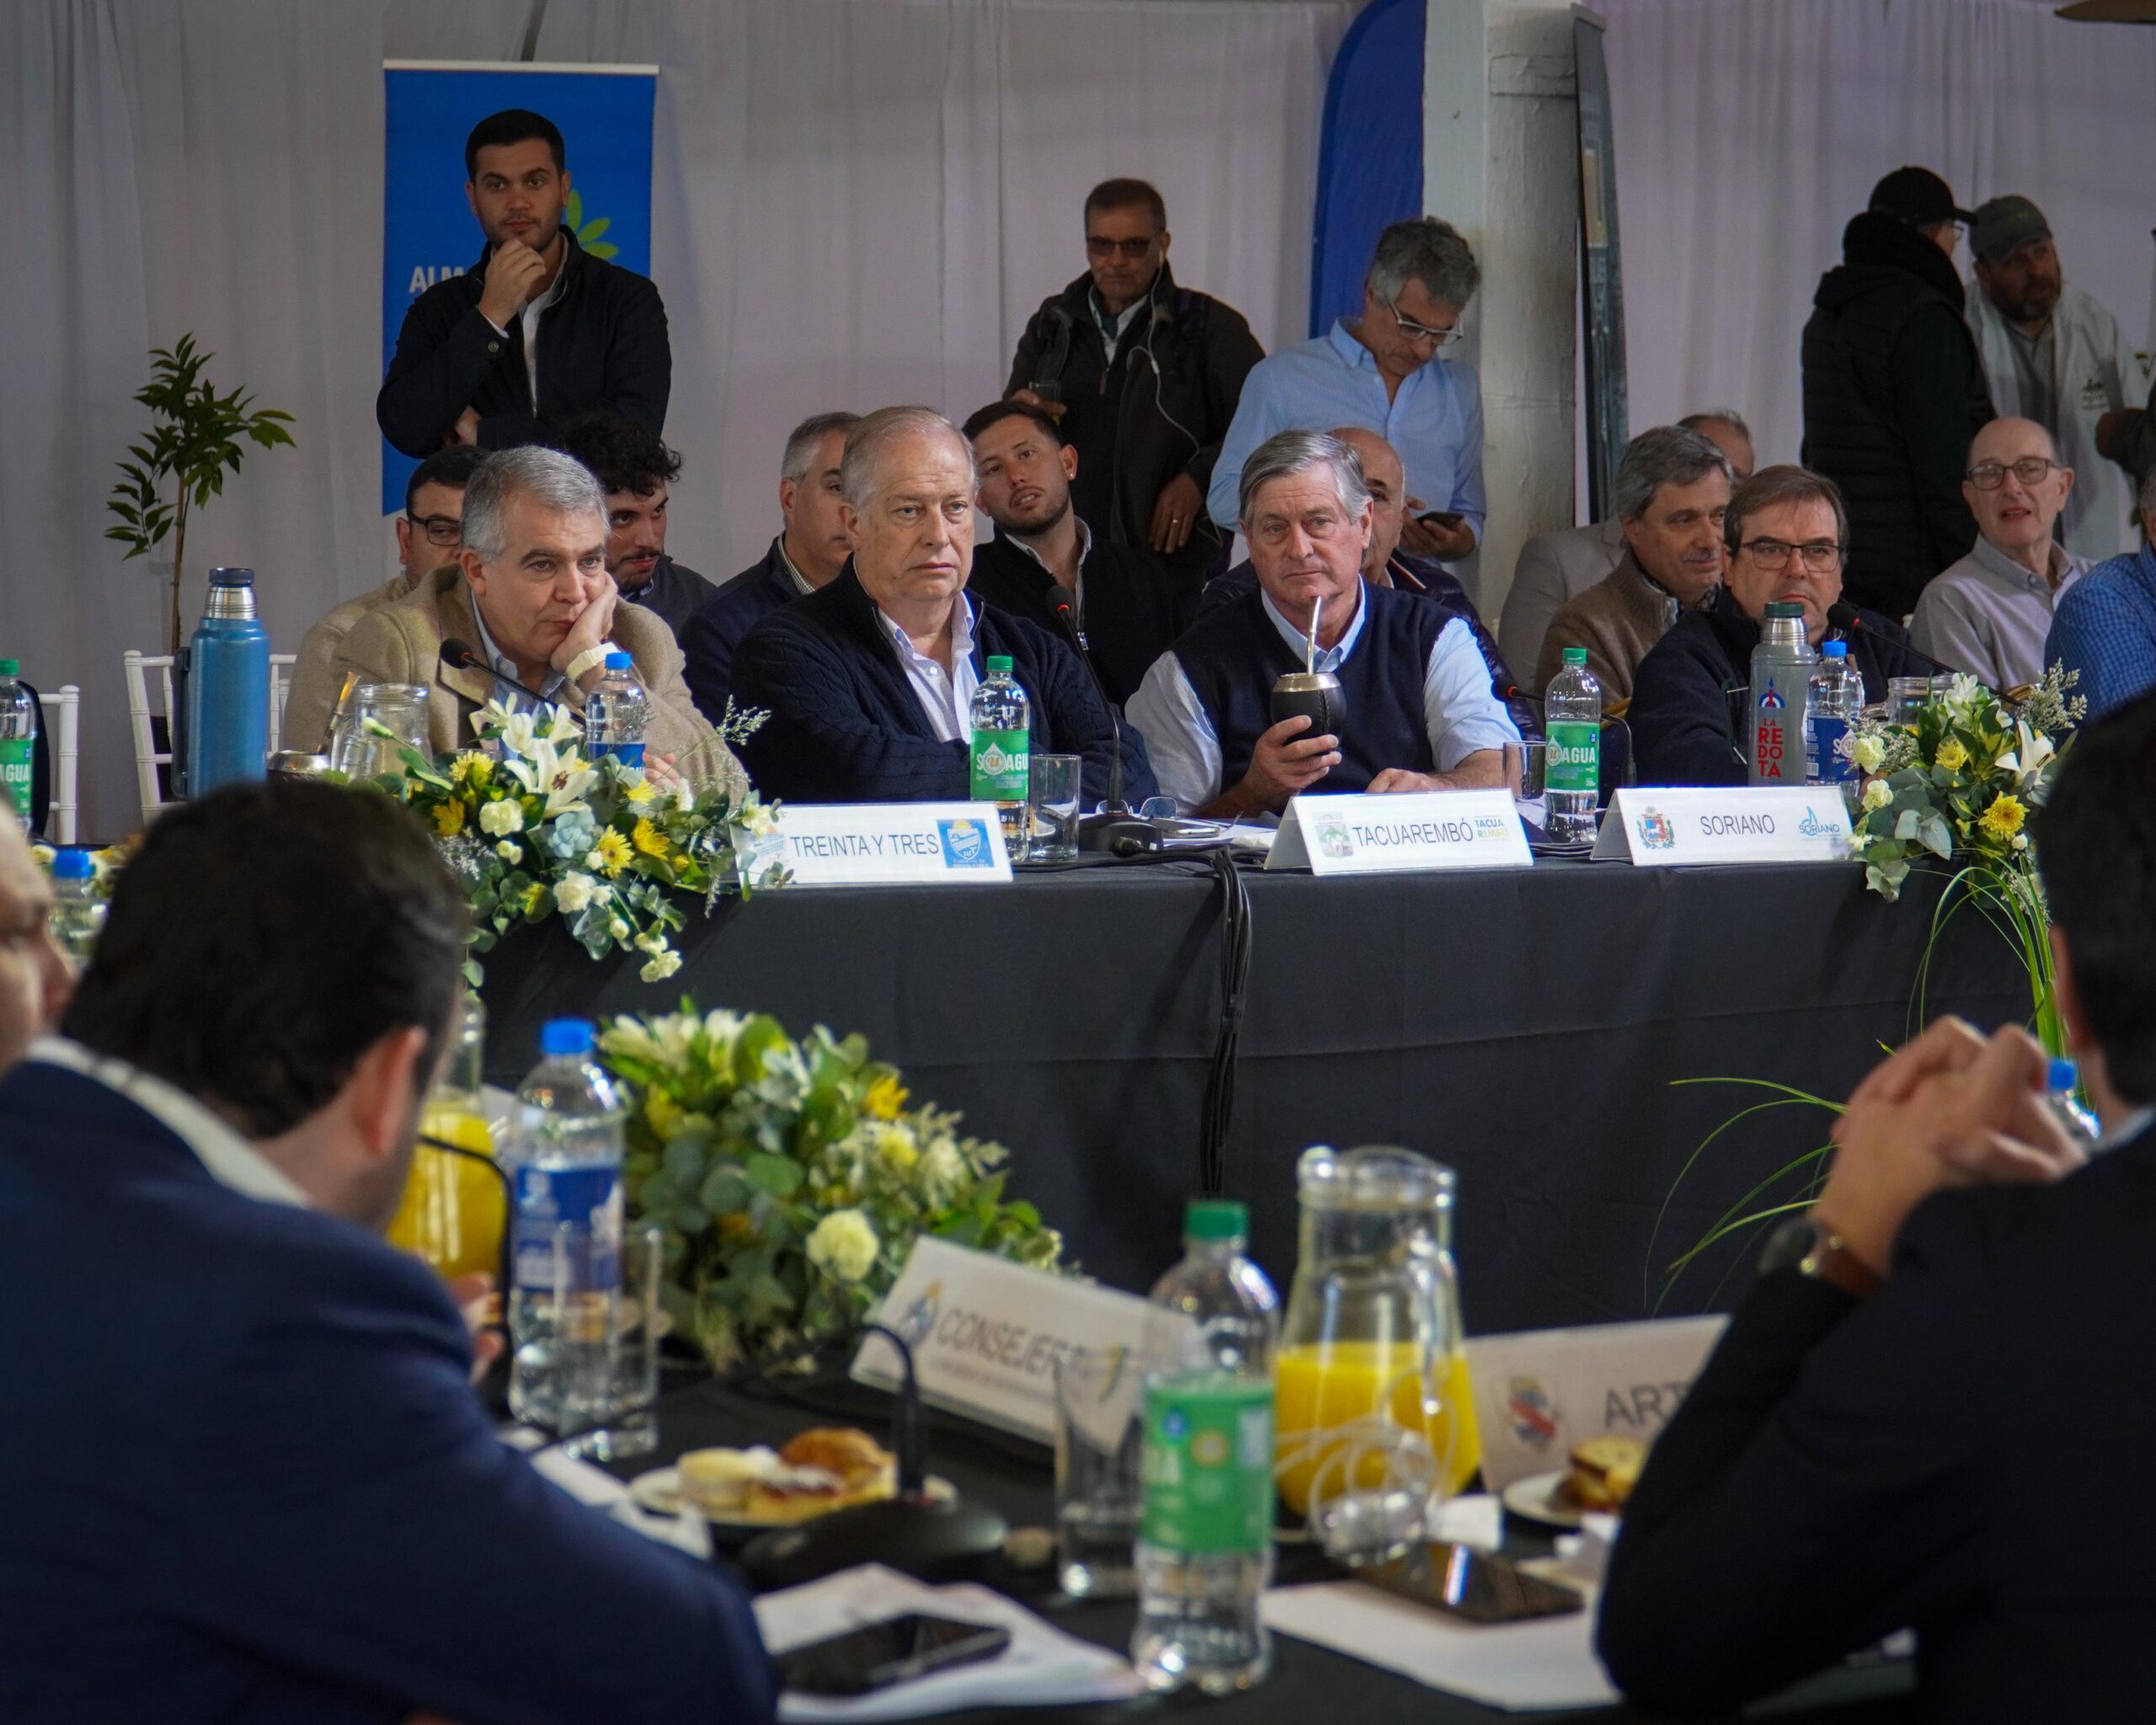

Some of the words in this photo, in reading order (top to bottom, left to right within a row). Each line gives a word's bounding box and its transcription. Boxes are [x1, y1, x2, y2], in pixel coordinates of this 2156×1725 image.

[1758, 728, 1784, 745] RE
[1561, 747, 1596, 763] AGUA
[1758, 745, 1784, 761] DO
[1758, 761, 1783, 777] TA
[1474, 818, 1504, 828] TACUA
[1700, 814, 1775, 836] SORIANO
[1798, 824, 1840, 834] SORIANO
[1352, 817, 1474, 847] TACUAREMBÓ
[789, 835, 870, 857] TREINTA
[871, 835, 885, 856] Y
[889, 834, 940, 855] TRES
